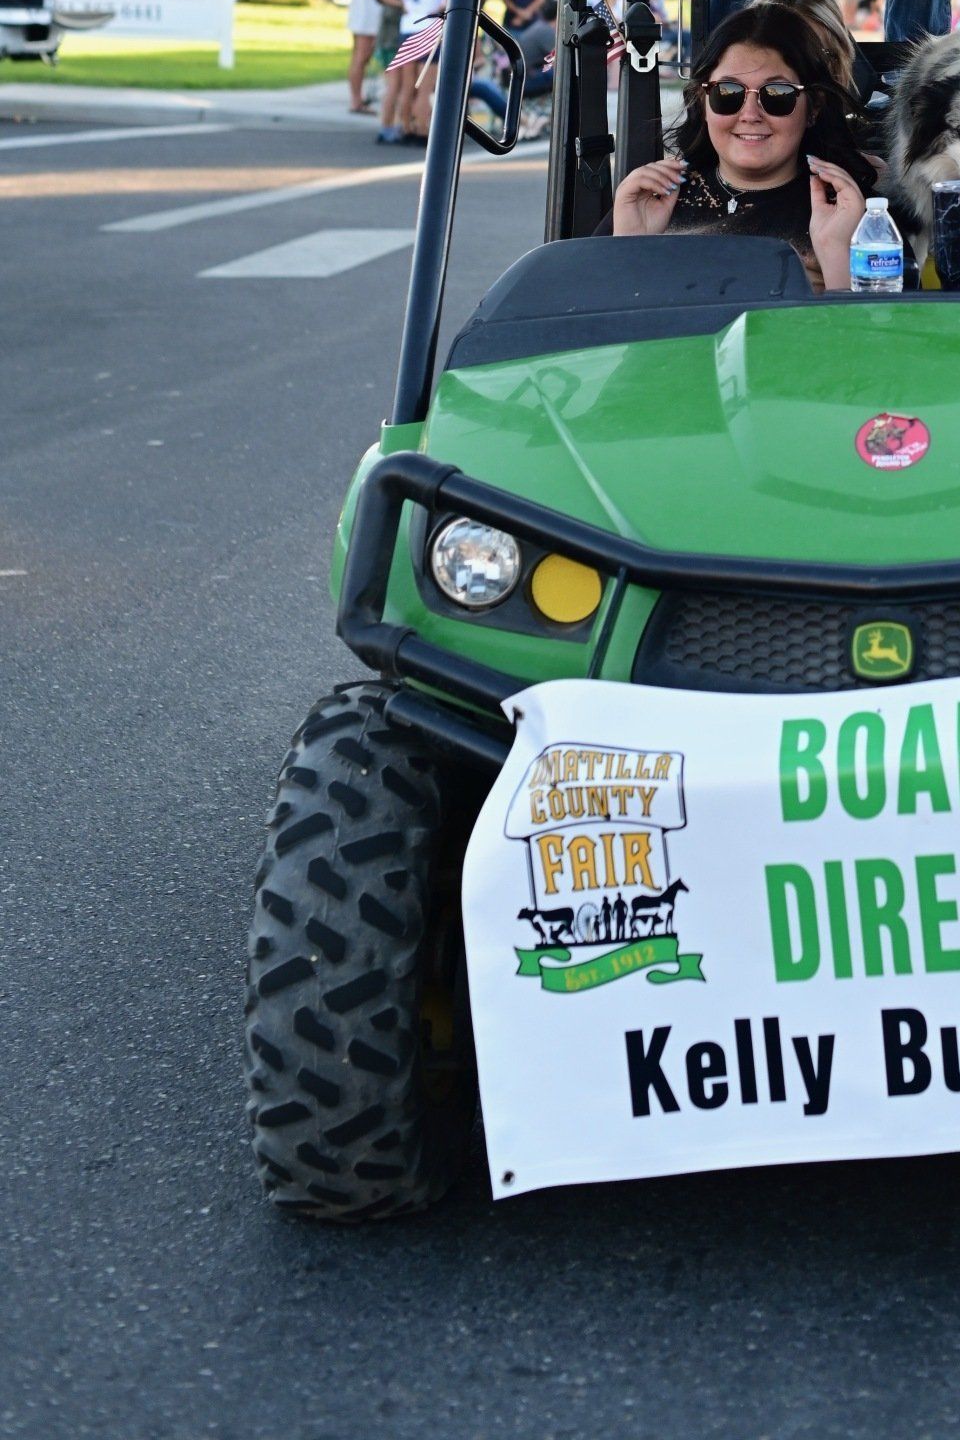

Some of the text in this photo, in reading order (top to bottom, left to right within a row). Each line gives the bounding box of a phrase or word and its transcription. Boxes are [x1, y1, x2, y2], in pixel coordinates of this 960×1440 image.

[529, 785, 660, 825] COUNTY
[535, 831, 663, 896] FAIR
[612, 944, 656, 976] 1912
[623, 1015, 837, 1119] Kelly
